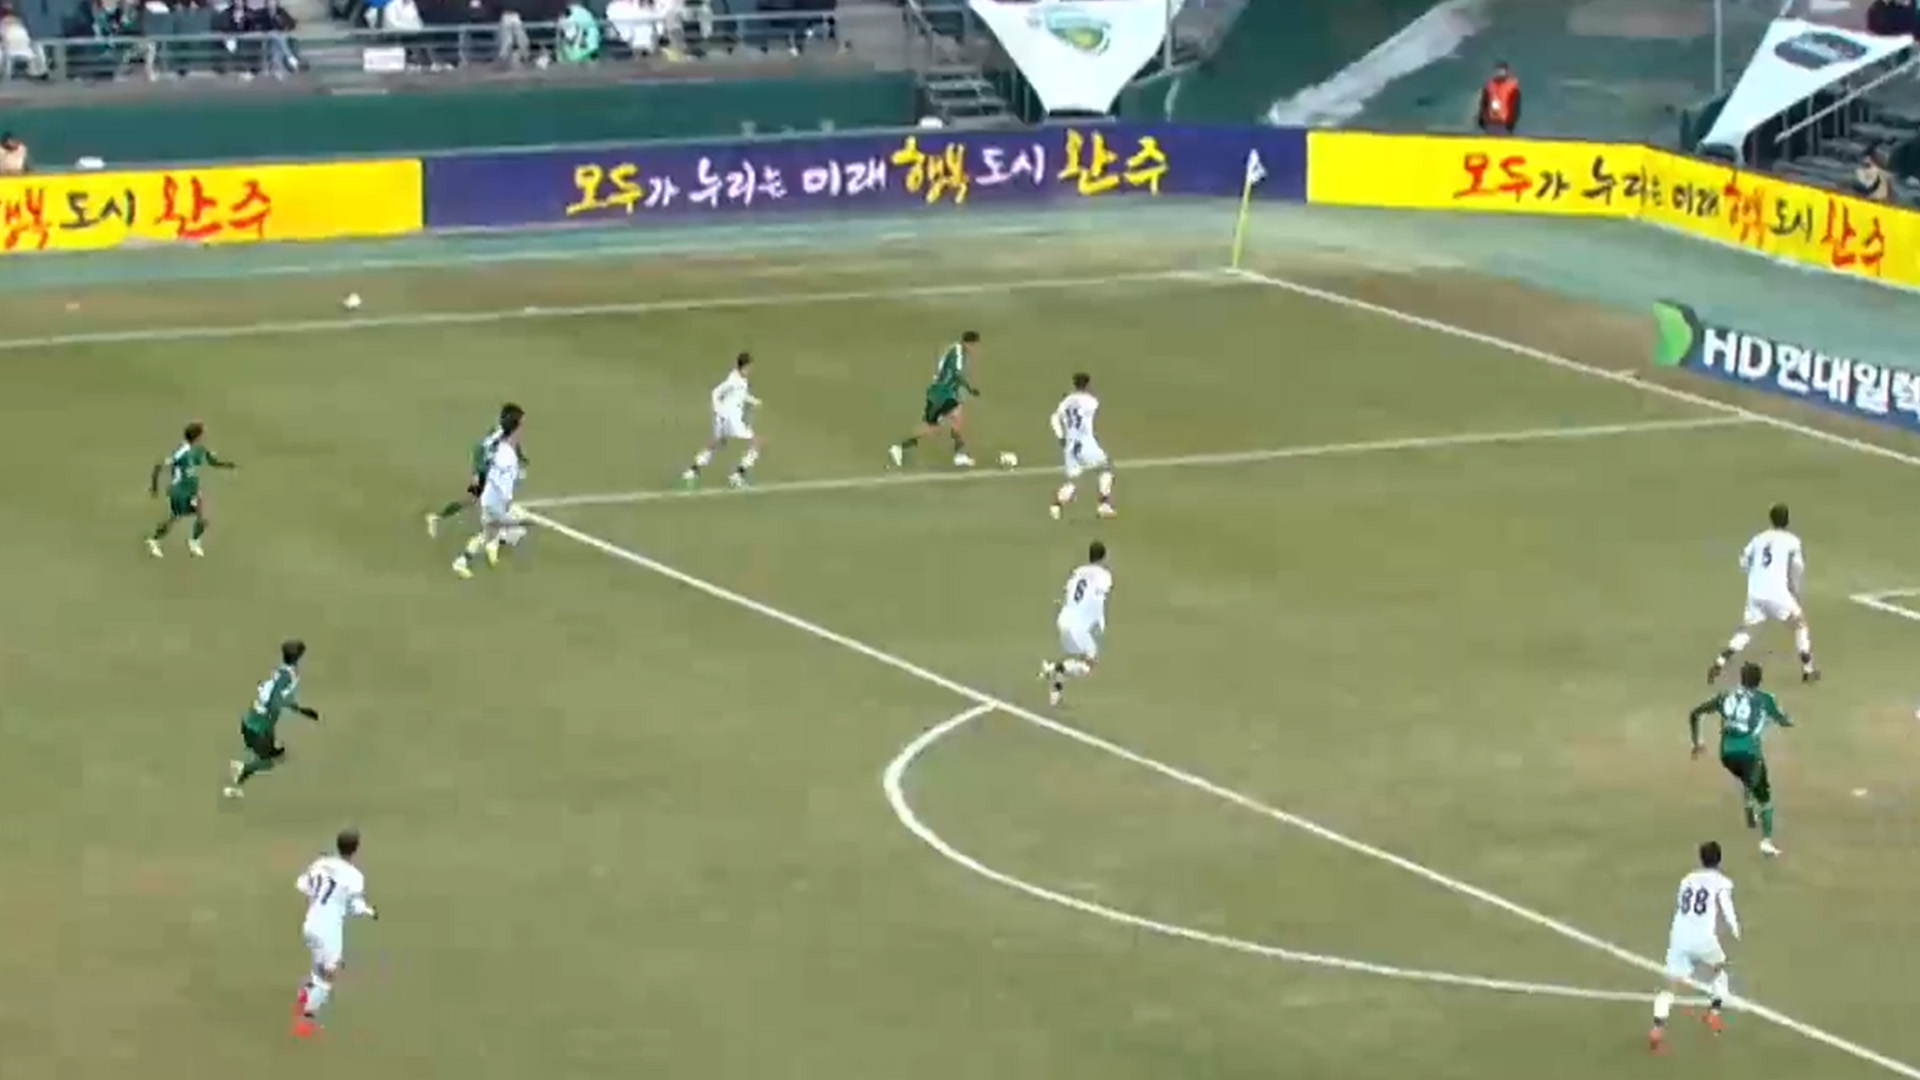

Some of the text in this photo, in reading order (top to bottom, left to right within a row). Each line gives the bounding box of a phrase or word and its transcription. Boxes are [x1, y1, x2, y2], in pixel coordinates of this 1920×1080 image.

[688, 157, 788, 206] 누리는
[1057, 129, 1168, 195] 완주
[154, 174, 271, 240] 완주
